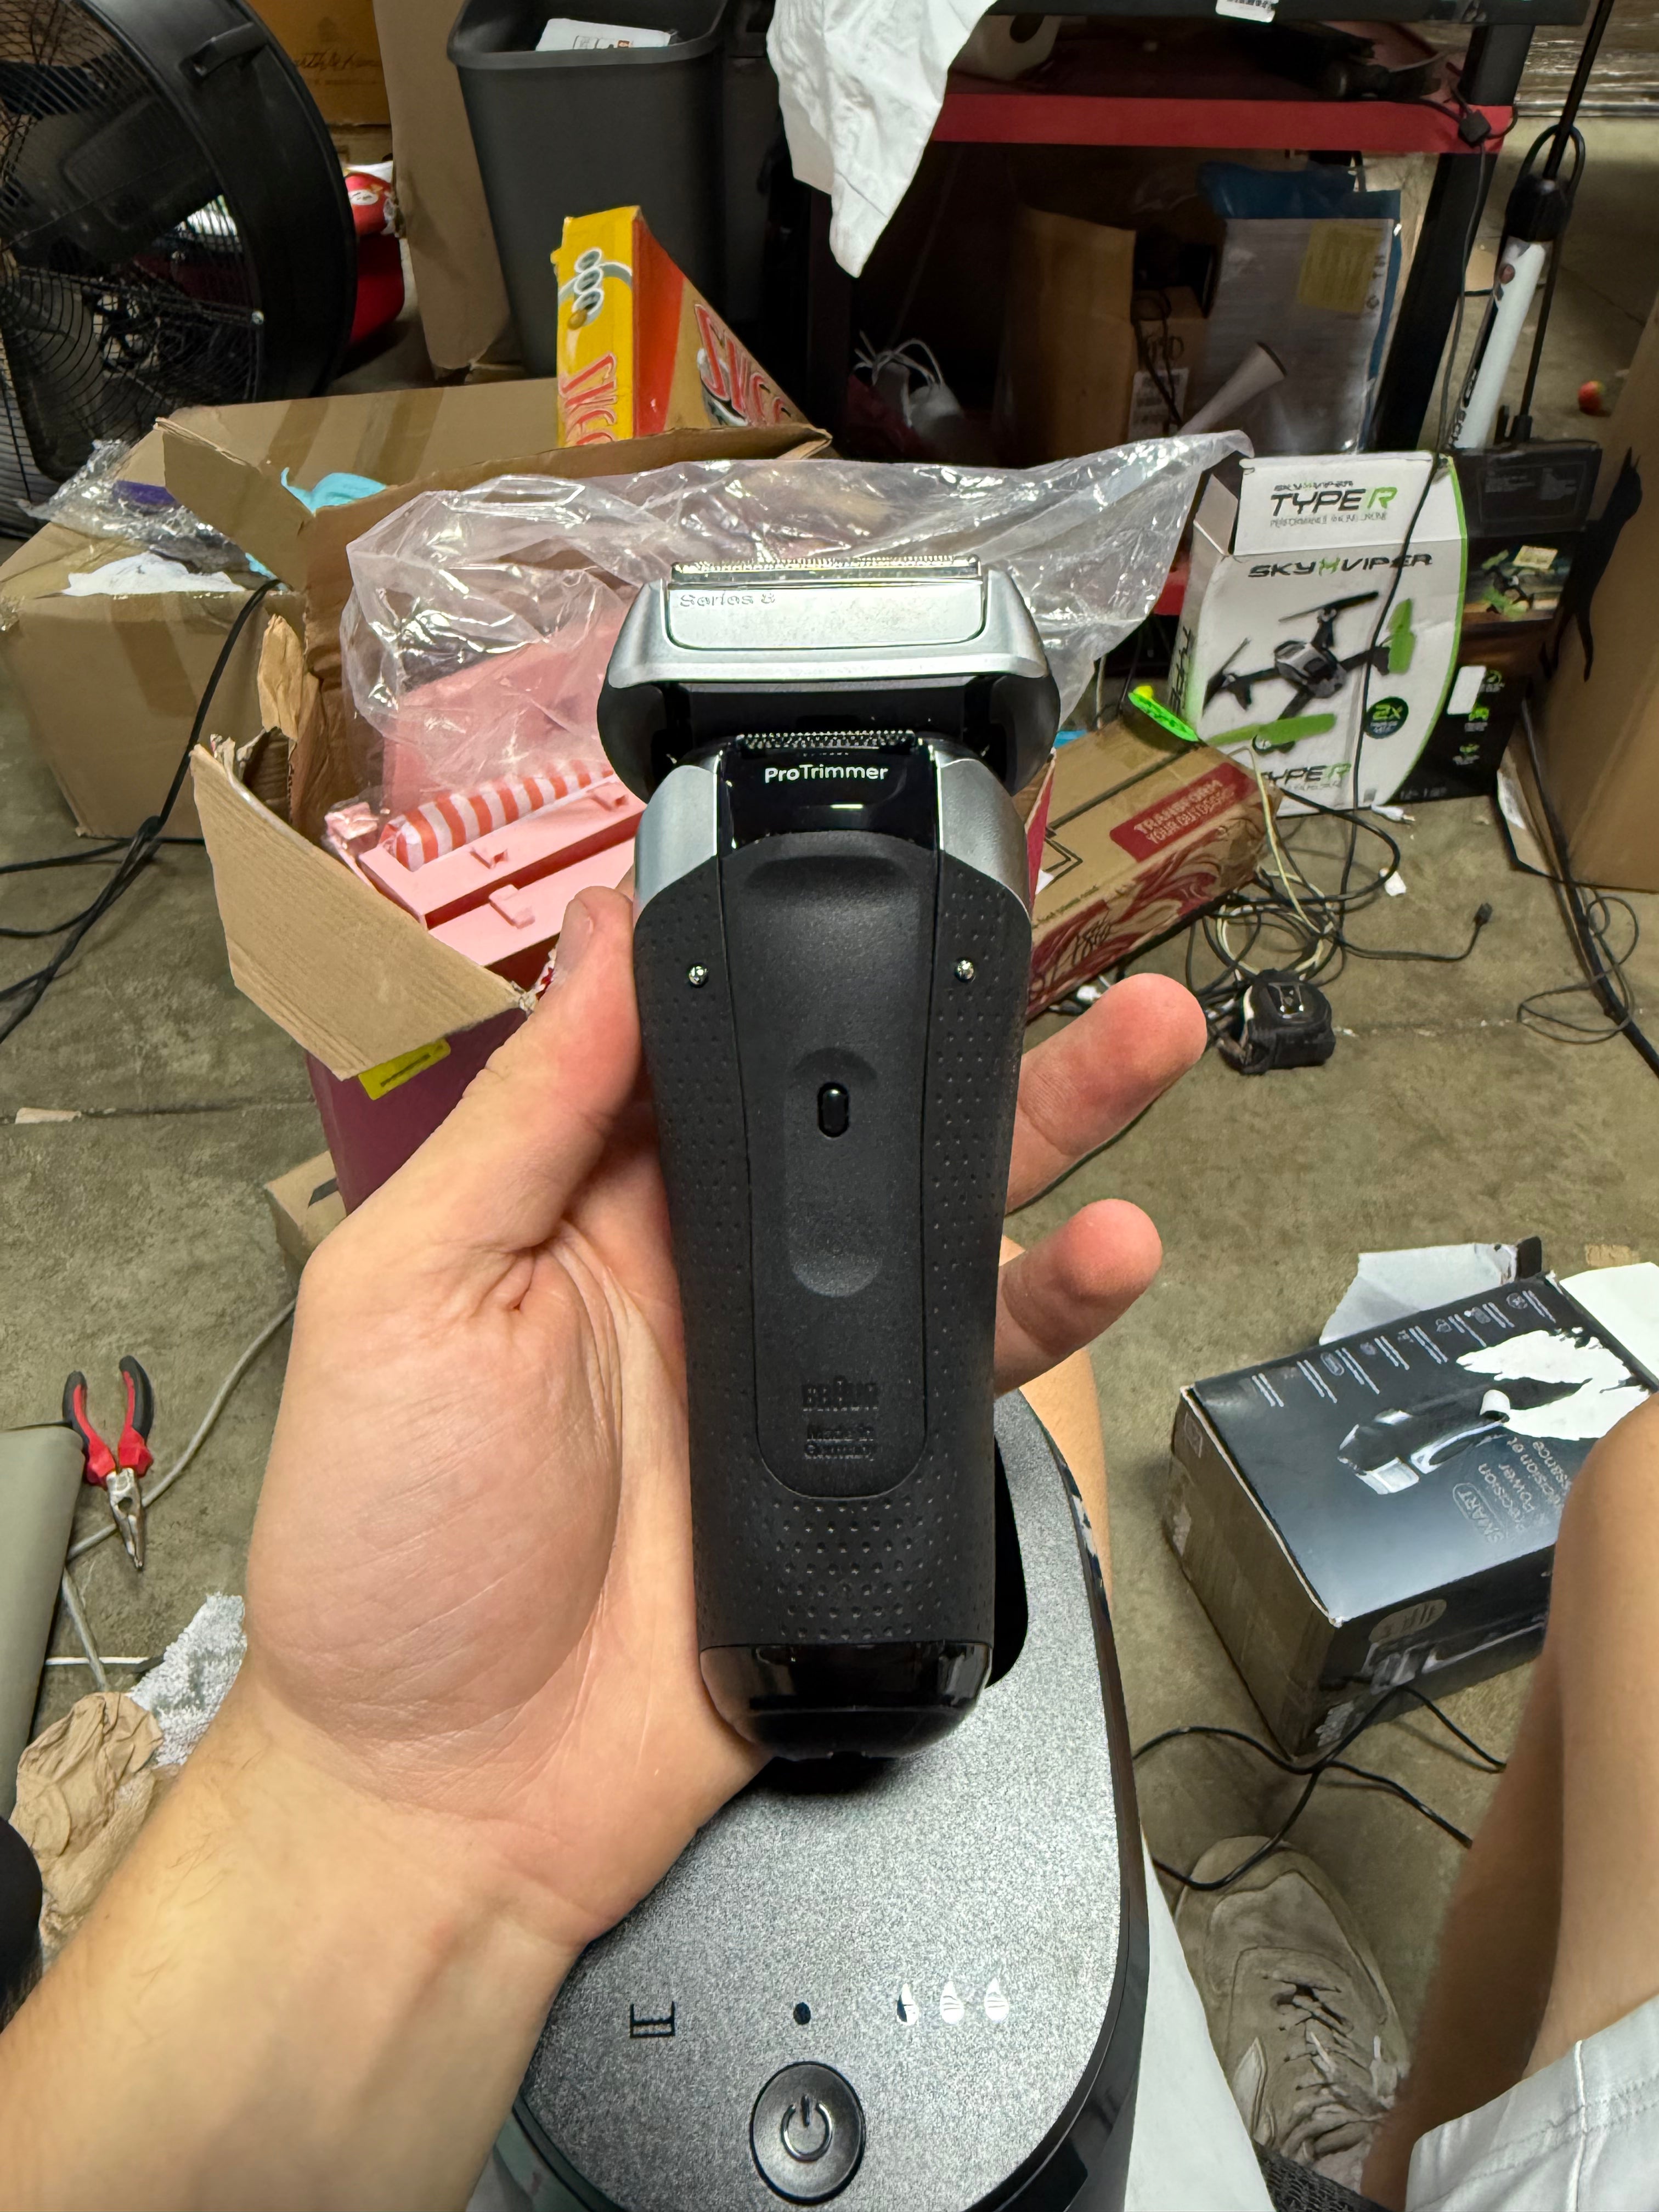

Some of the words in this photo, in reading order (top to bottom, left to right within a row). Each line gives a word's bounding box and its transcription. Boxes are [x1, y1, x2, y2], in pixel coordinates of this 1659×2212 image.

[1271, 488, 1366, 516] TYPE
[1367, 487, 1398, 509] R
[680, 592, 754, 607] Series
[764, 763, 889, 783] ProTrimmer
[1478, 1463, 1527, 1532] Precision
[1498, 1464, 1536, 1513] Power
[1457, 1491, 1505, 1543] SMART
